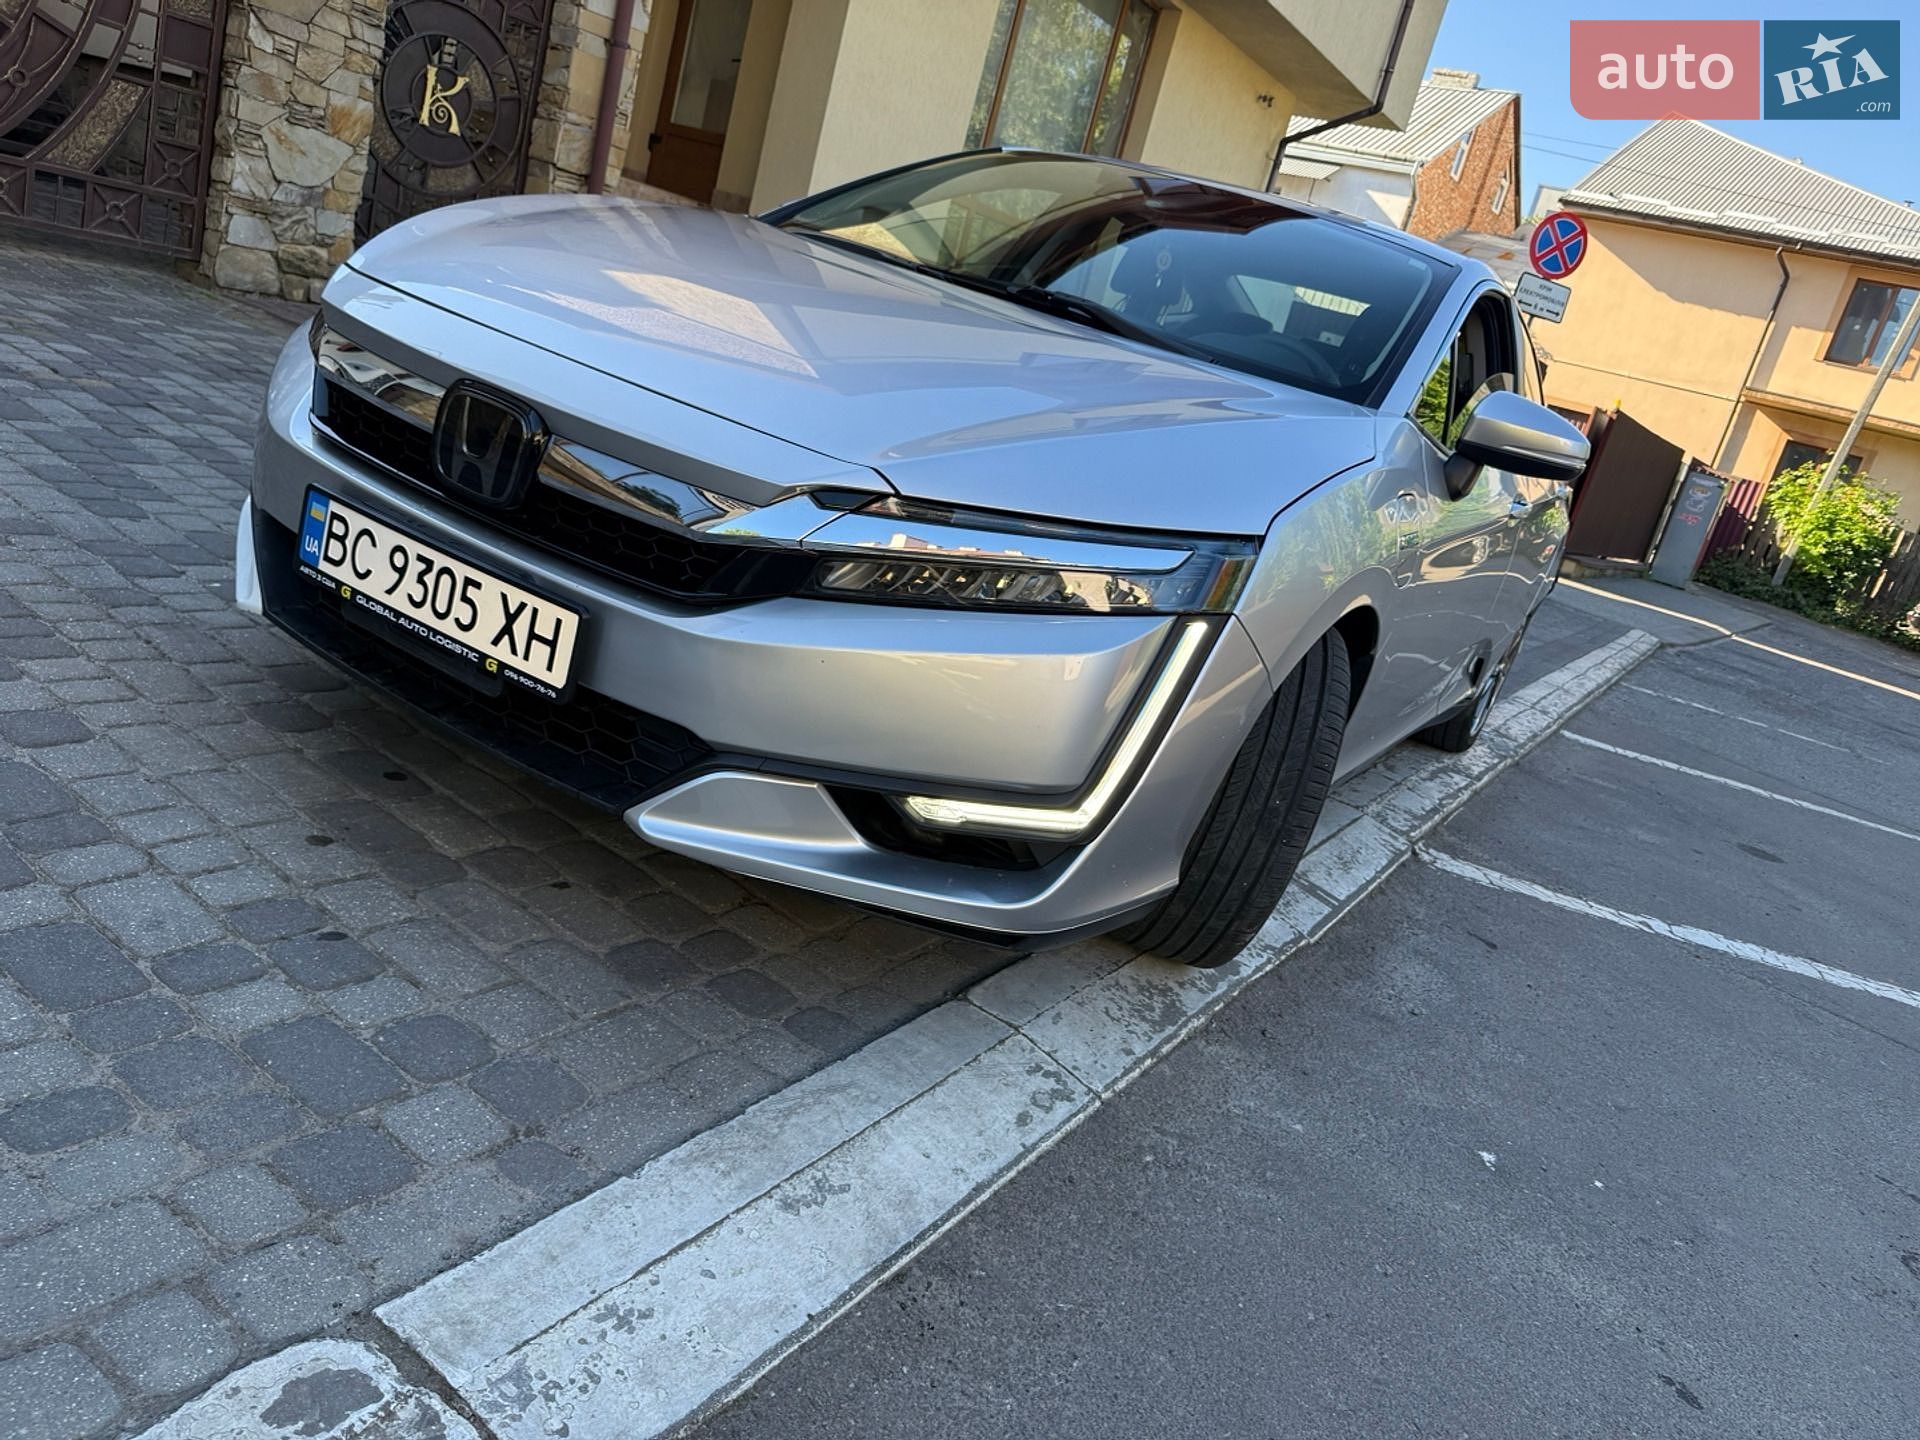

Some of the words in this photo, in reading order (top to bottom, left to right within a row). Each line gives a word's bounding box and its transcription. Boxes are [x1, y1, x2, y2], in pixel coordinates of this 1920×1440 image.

[305, 536, 319, 558] UA
[322, 511, 378, 581] BC
[384, 544, 483, 632] 9305
[491, 591, 562, 673] XH
[356, 595, 397, 622] GLOBAL
[398, 617, 429, 639] AUTO
[429, 631, 480, 663] LOGISTIC
